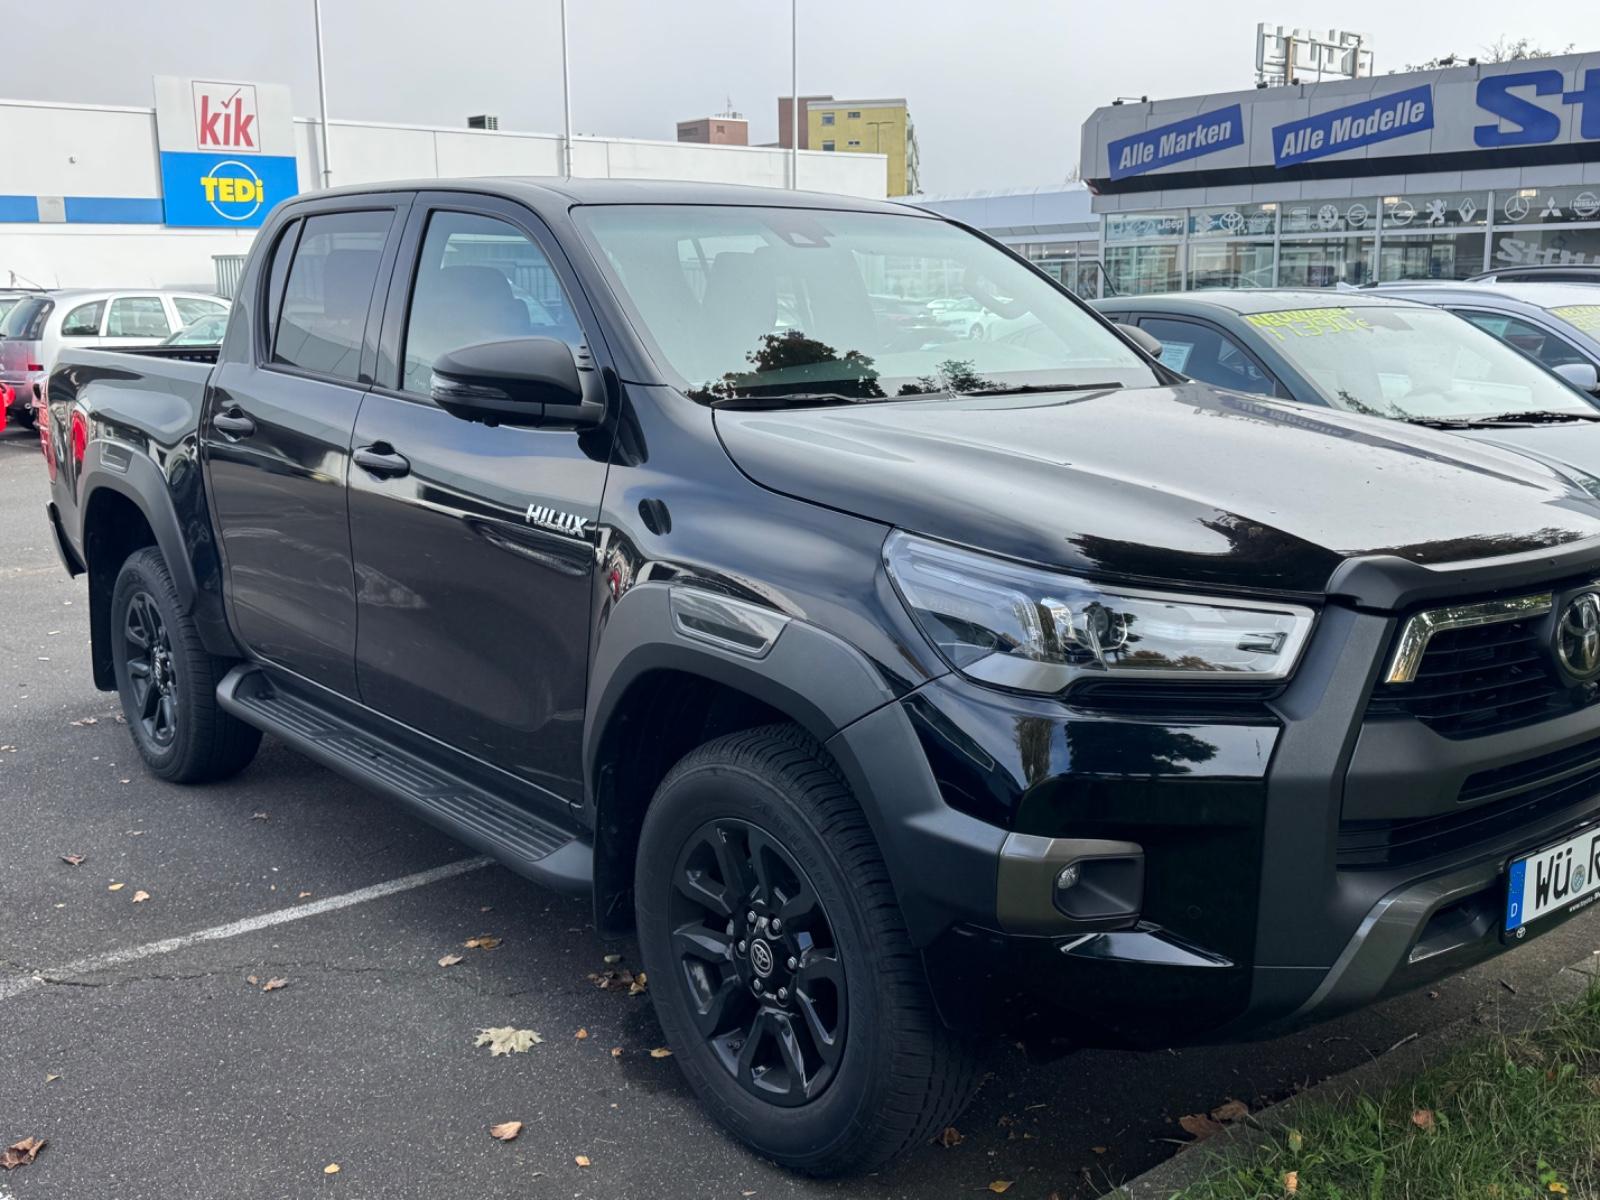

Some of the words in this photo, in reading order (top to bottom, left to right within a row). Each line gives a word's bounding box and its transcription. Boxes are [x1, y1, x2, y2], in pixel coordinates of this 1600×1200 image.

[200, 88, 255, 147] kik
[1280, 127, 1324, 159] Alle
[1329, 100, 1426, 146] Modelle
[1118, 142, 1155, 170] Alle
[1158, 120, 1232, 158] Marken
[201, 177, 264, 203] TEDi
[1157, 217, 1184, 230] Jeep
[525, 503, 588, 538] HILUX
[1510, 902, 1518, 918] D
